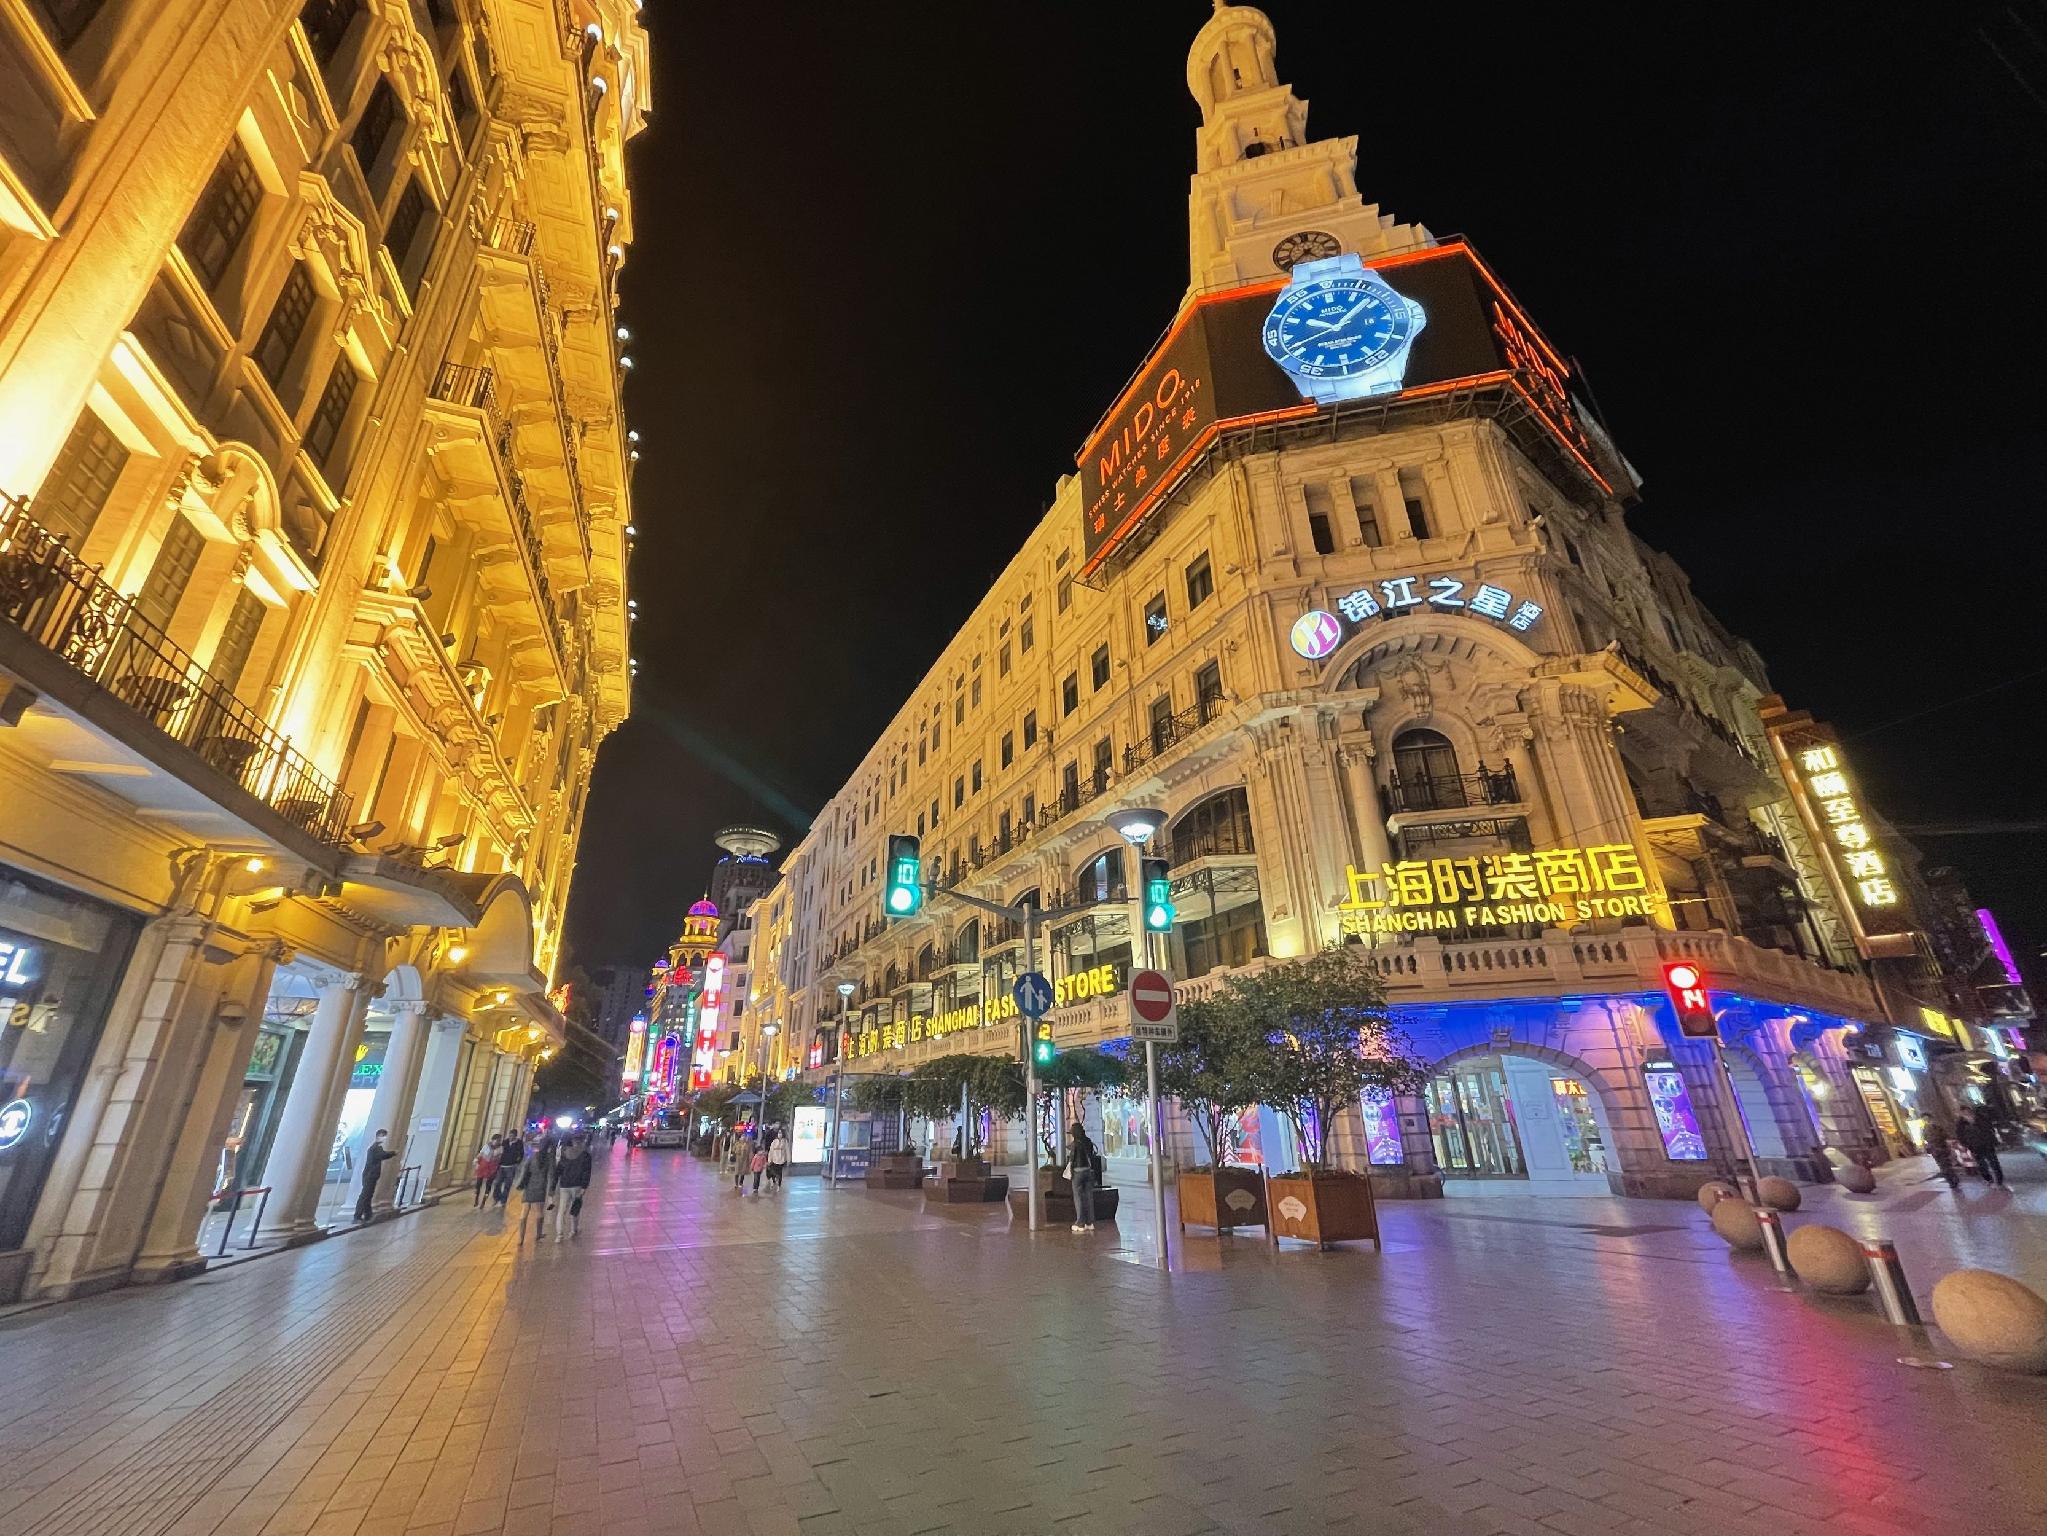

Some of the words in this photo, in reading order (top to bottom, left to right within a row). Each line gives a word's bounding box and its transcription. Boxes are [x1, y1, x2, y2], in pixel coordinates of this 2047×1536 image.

[1101, 369, 1180, 486] MIDO
[1088, 489, 1110, 519] SWISS
[1112, 443, 1148, 489] WATCHES
[1151, 407, 1178, 442] SINCE
[1338, 575, 1512, 621] 锦江之星
[1509, 600, 1543, 631] 酒店
[898, 864, 914, 885] 10
[1338, 843, 1646, 910] 上海时装商店
[1342, 910, 1457, 934] SHANGHAI
[1467, 901, 1565, 927] FASHION
[1577, 893, 1657, 919] STORE
[925, 1004, 978, 1037] SHANGHAI
[985, 993, 1019, 1020] FASH
[1054, 964, 1115, 1004] STORE
